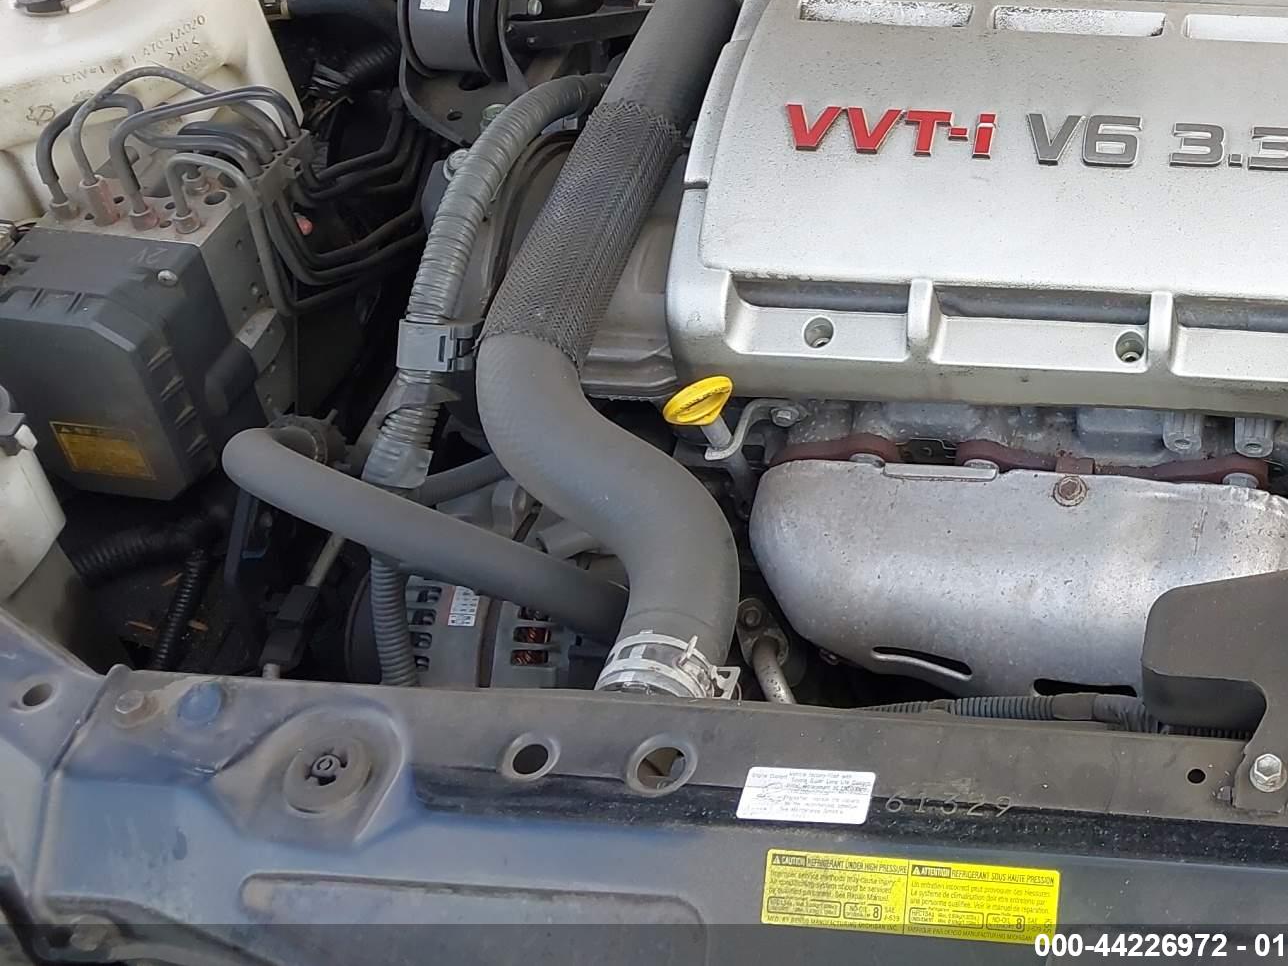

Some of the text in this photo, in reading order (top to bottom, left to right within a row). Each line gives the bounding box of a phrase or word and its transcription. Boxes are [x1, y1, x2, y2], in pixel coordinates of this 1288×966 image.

[785, 103, 998, 159] VVT-i
[1027, 112, 1144, 167] V6
[885, 792, 1012, 818] 61329
[781, 856, 805, 866] CAUTION
[807, 858, 908, 873] REFRIGERANT UNDER HIGH PRESSURE
[920, 866, 950, 877] ATTENTION
[991, 872, 1006, 881] SOUS
[1008, 873, 1025, 882] HAUTE
[1027, 875, 1054, 885] PRESSION
[873, 906, 880, 918] 8
[1016, 918, 1023, 929] 8
